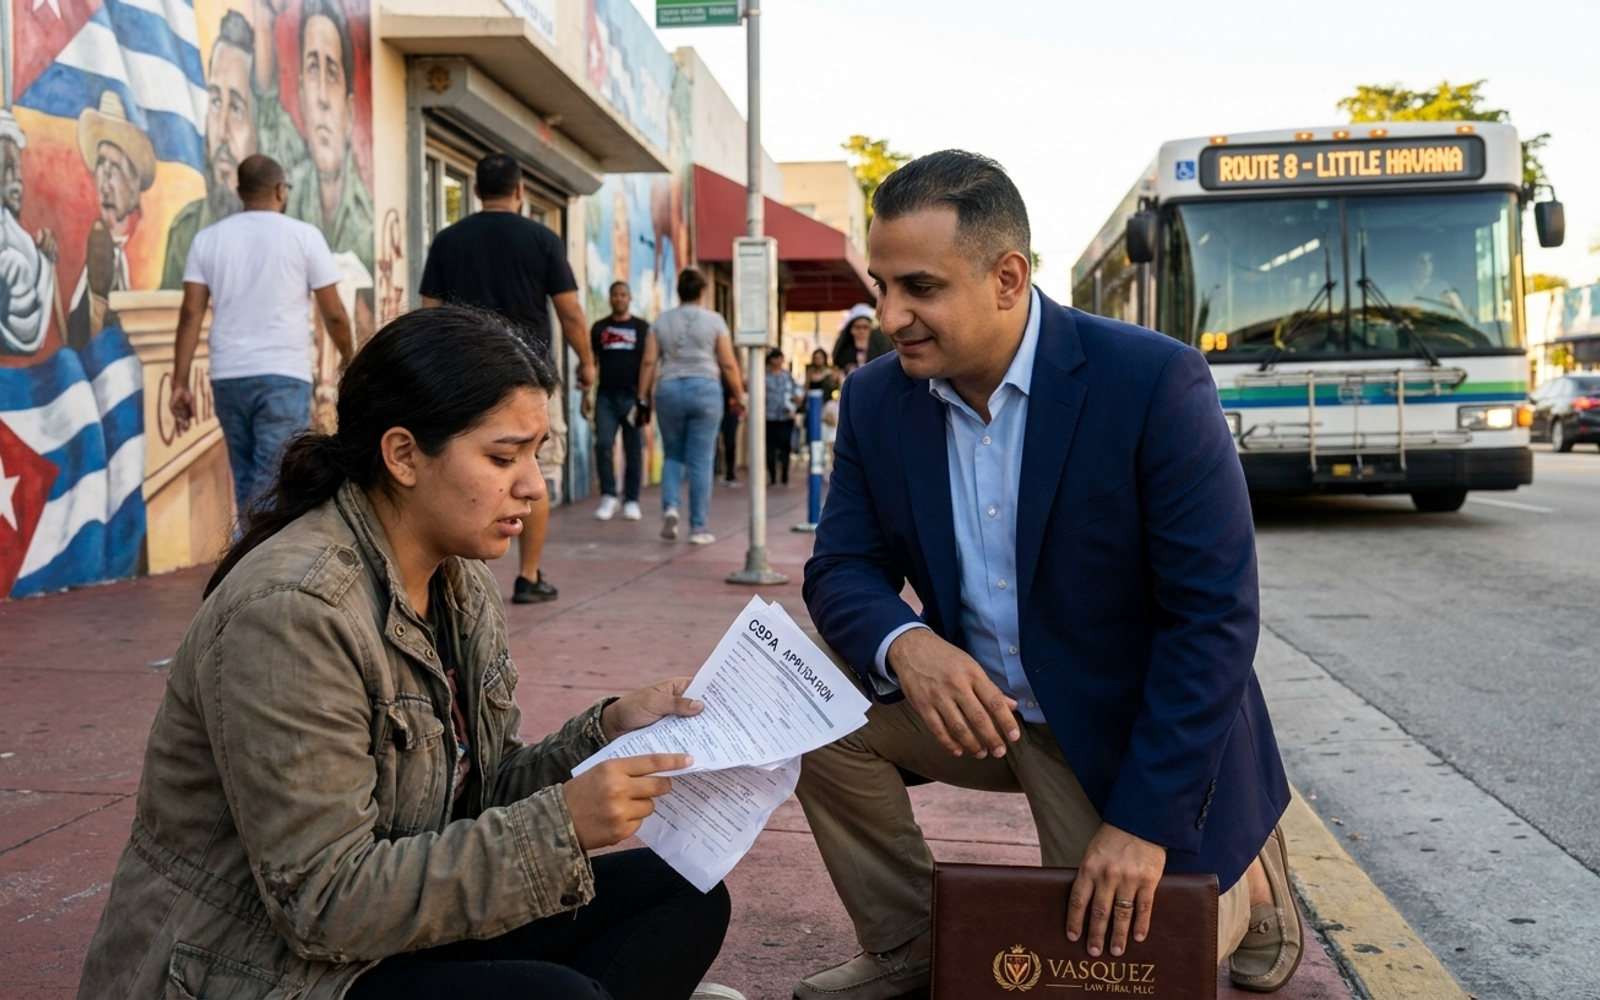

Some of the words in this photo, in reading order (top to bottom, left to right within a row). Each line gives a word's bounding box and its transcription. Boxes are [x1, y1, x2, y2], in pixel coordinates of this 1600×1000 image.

[1219, 153, 1280, 182] ROUTE
[1284, 153, 1299, 179] 8
[1316, 149, 1382, 178] LITTLE
[1386, 146, 1463, 175] HAVANA
[1047, 958, 1155, 984] VASQUEZ
[1084, 983, 1104, 992] LAW
